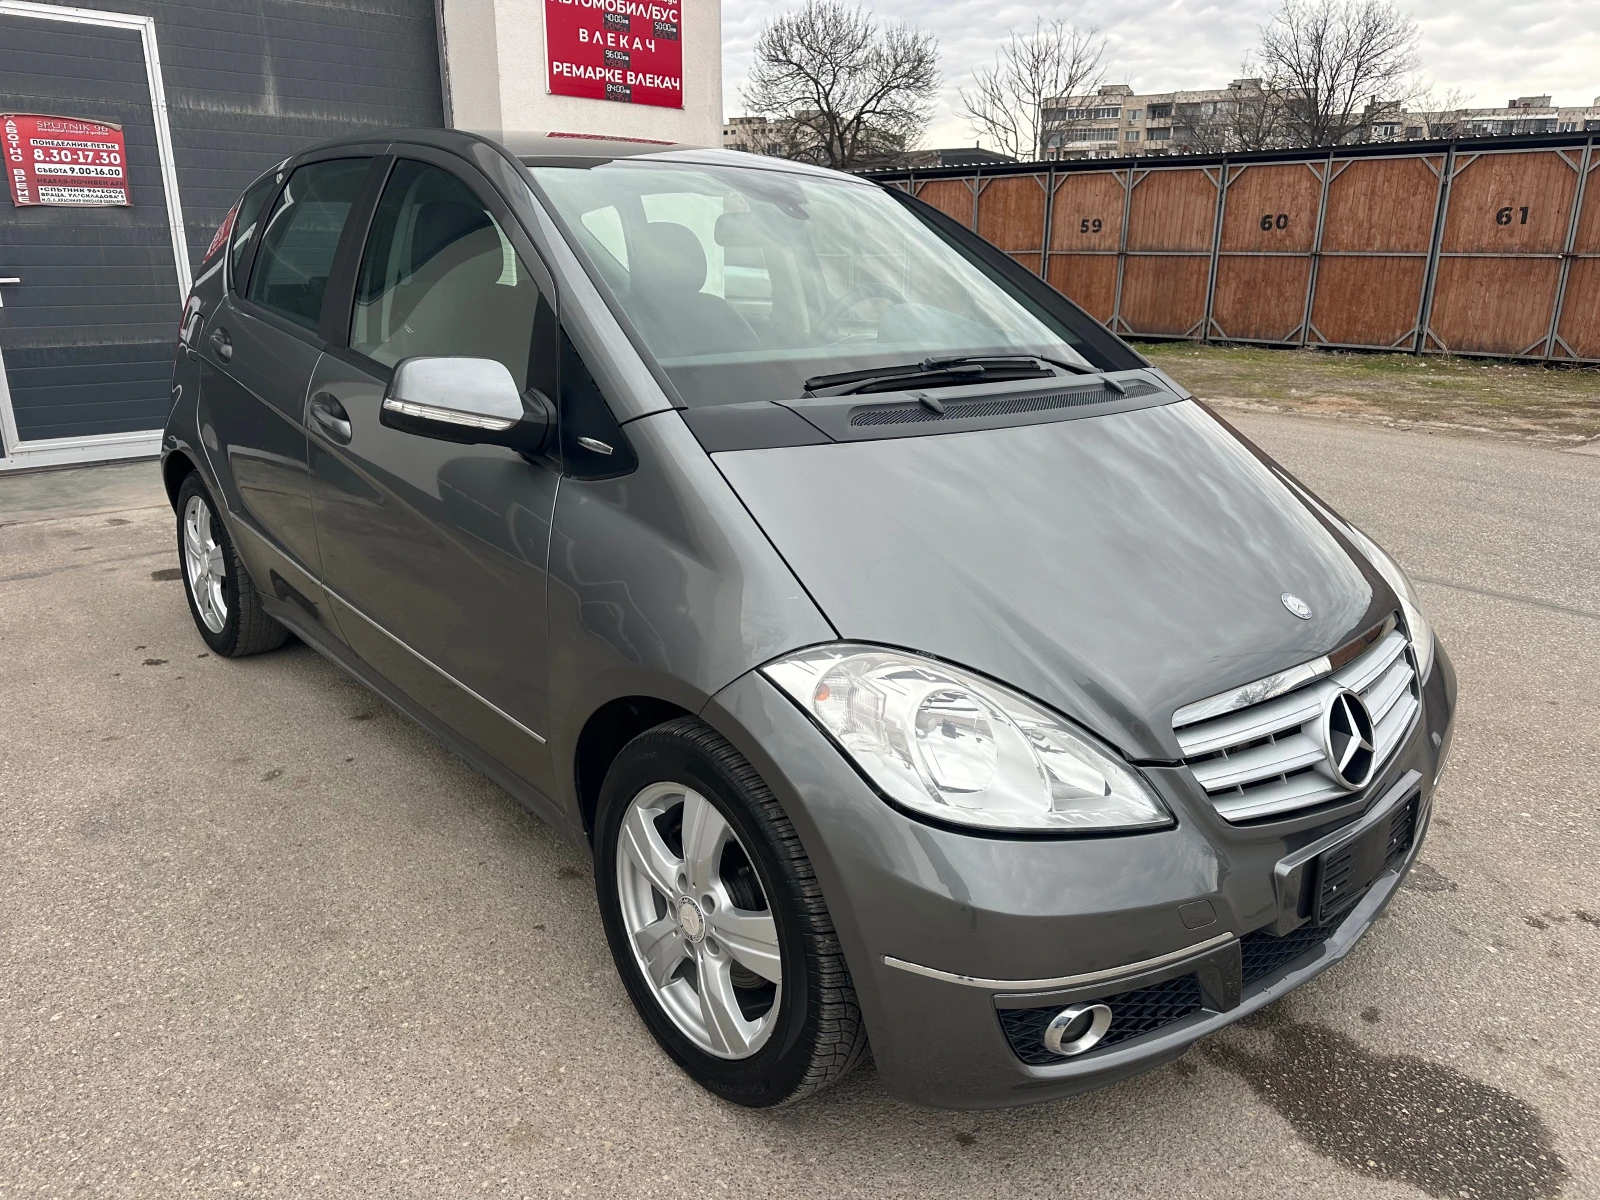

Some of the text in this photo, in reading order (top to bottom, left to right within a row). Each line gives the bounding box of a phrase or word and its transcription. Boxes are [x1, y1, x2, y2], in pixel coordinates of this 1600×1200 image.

[578, 28, 655, 52] ВЛЕКАЧ
[553, 61, 680, 90] РЕМАРКЕ ВЛЕКАЧ
[36, 120, 109, 132] SPUTNIK 96
[33, 148, 121, 165] 8.30-17.30
[69, 166, 121, 177] 9.00-16.00
[1260, 213, 1289, 231] 60
[1496, 206, 1529, 226] 61
[1080, 218, 1103, 234] 59
